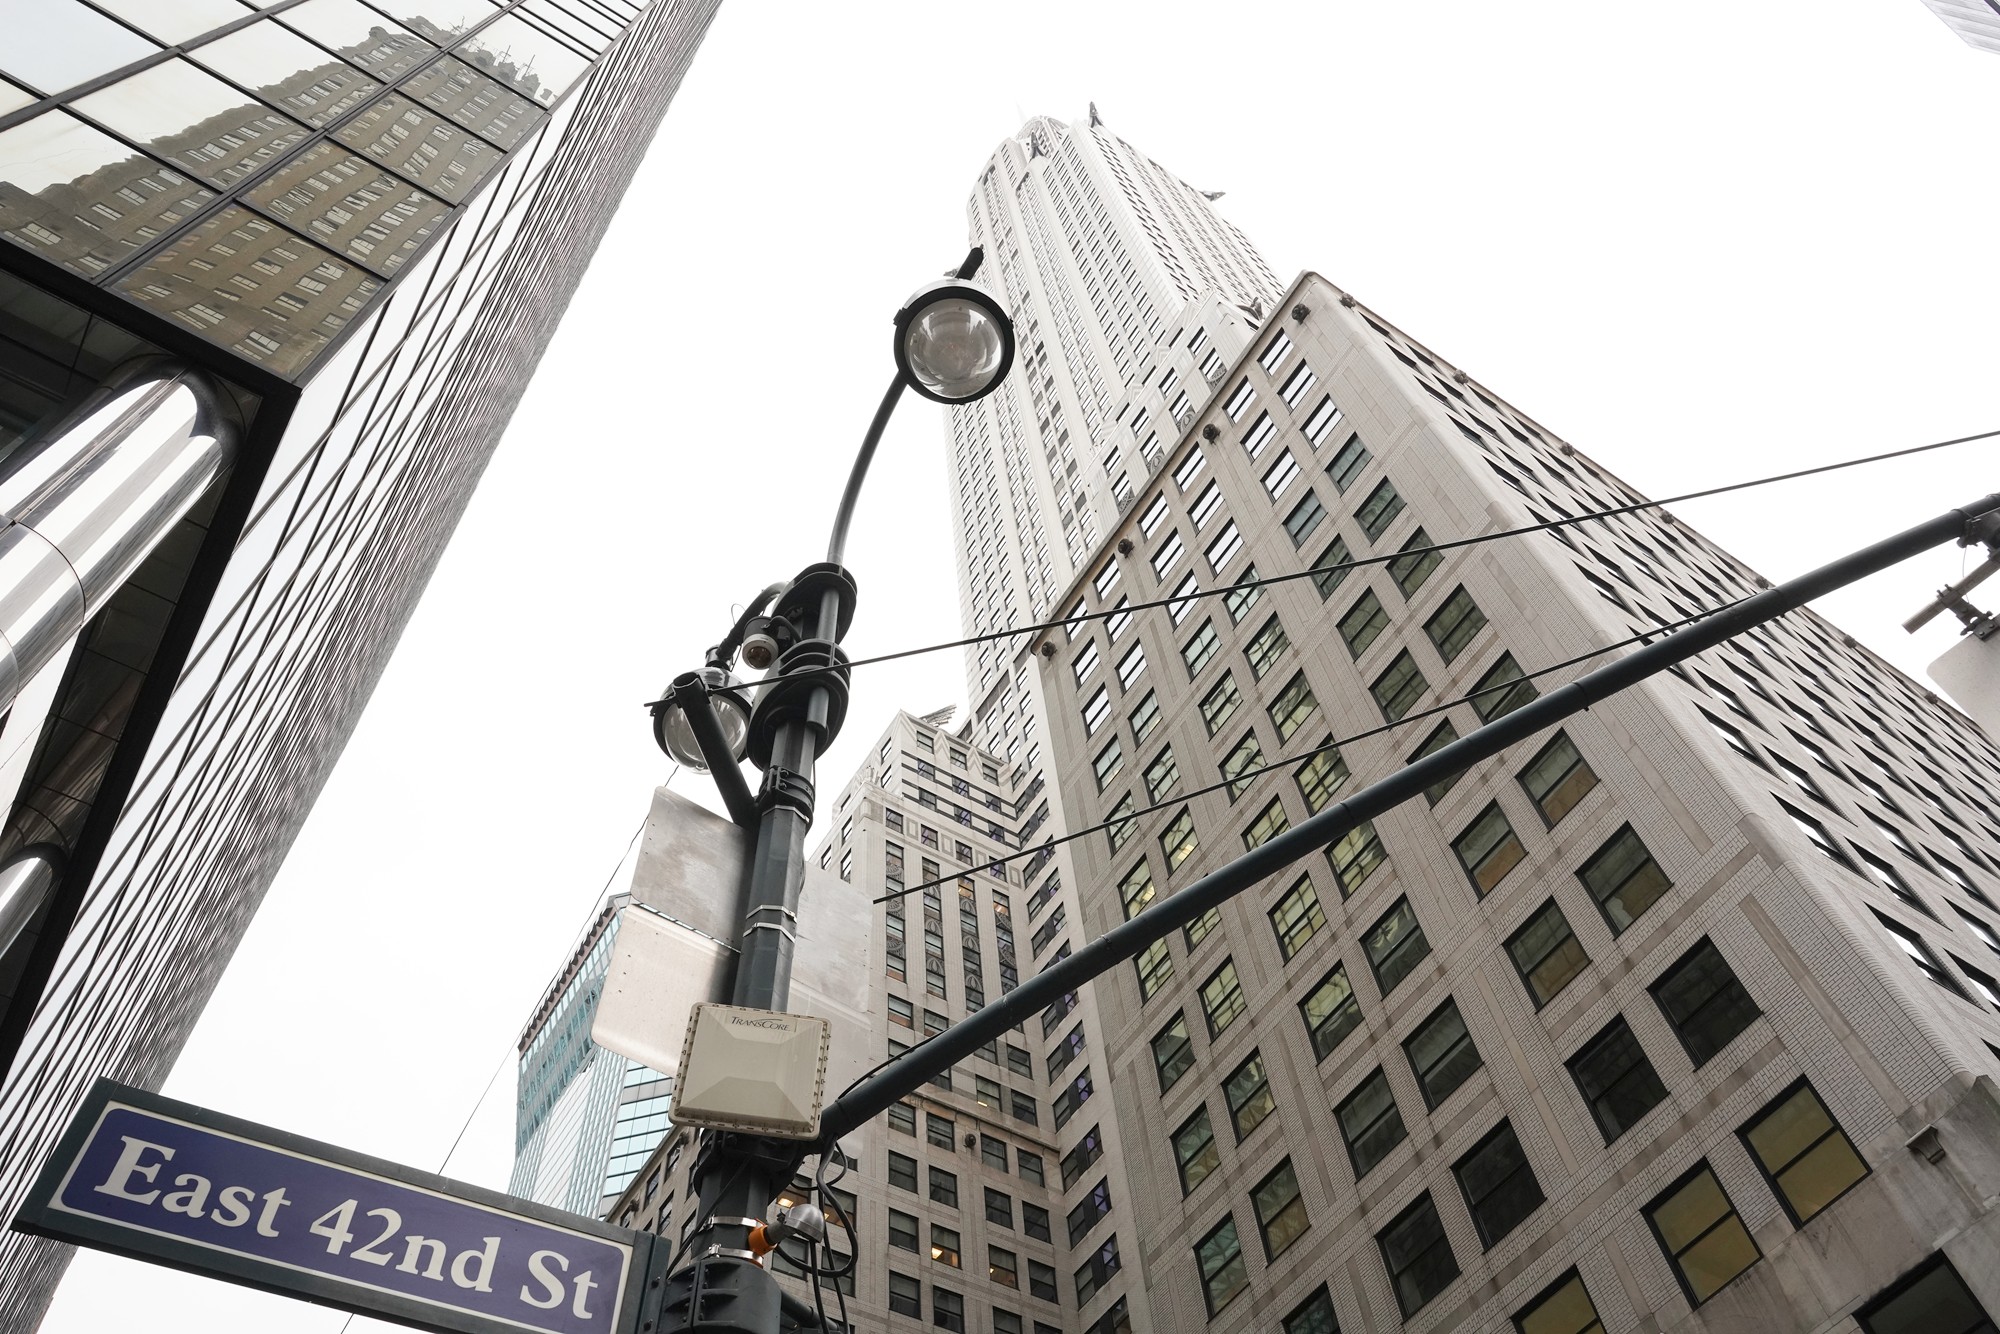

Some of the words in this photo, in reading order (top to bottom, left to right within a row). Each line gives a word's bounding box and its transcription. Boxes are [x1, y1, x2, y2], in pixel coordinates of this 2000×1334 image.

[94, 1135, 292, 1238] East
[309, 1198, 502, 1293] 42nd
[519, 1249, 599, 1320] St
